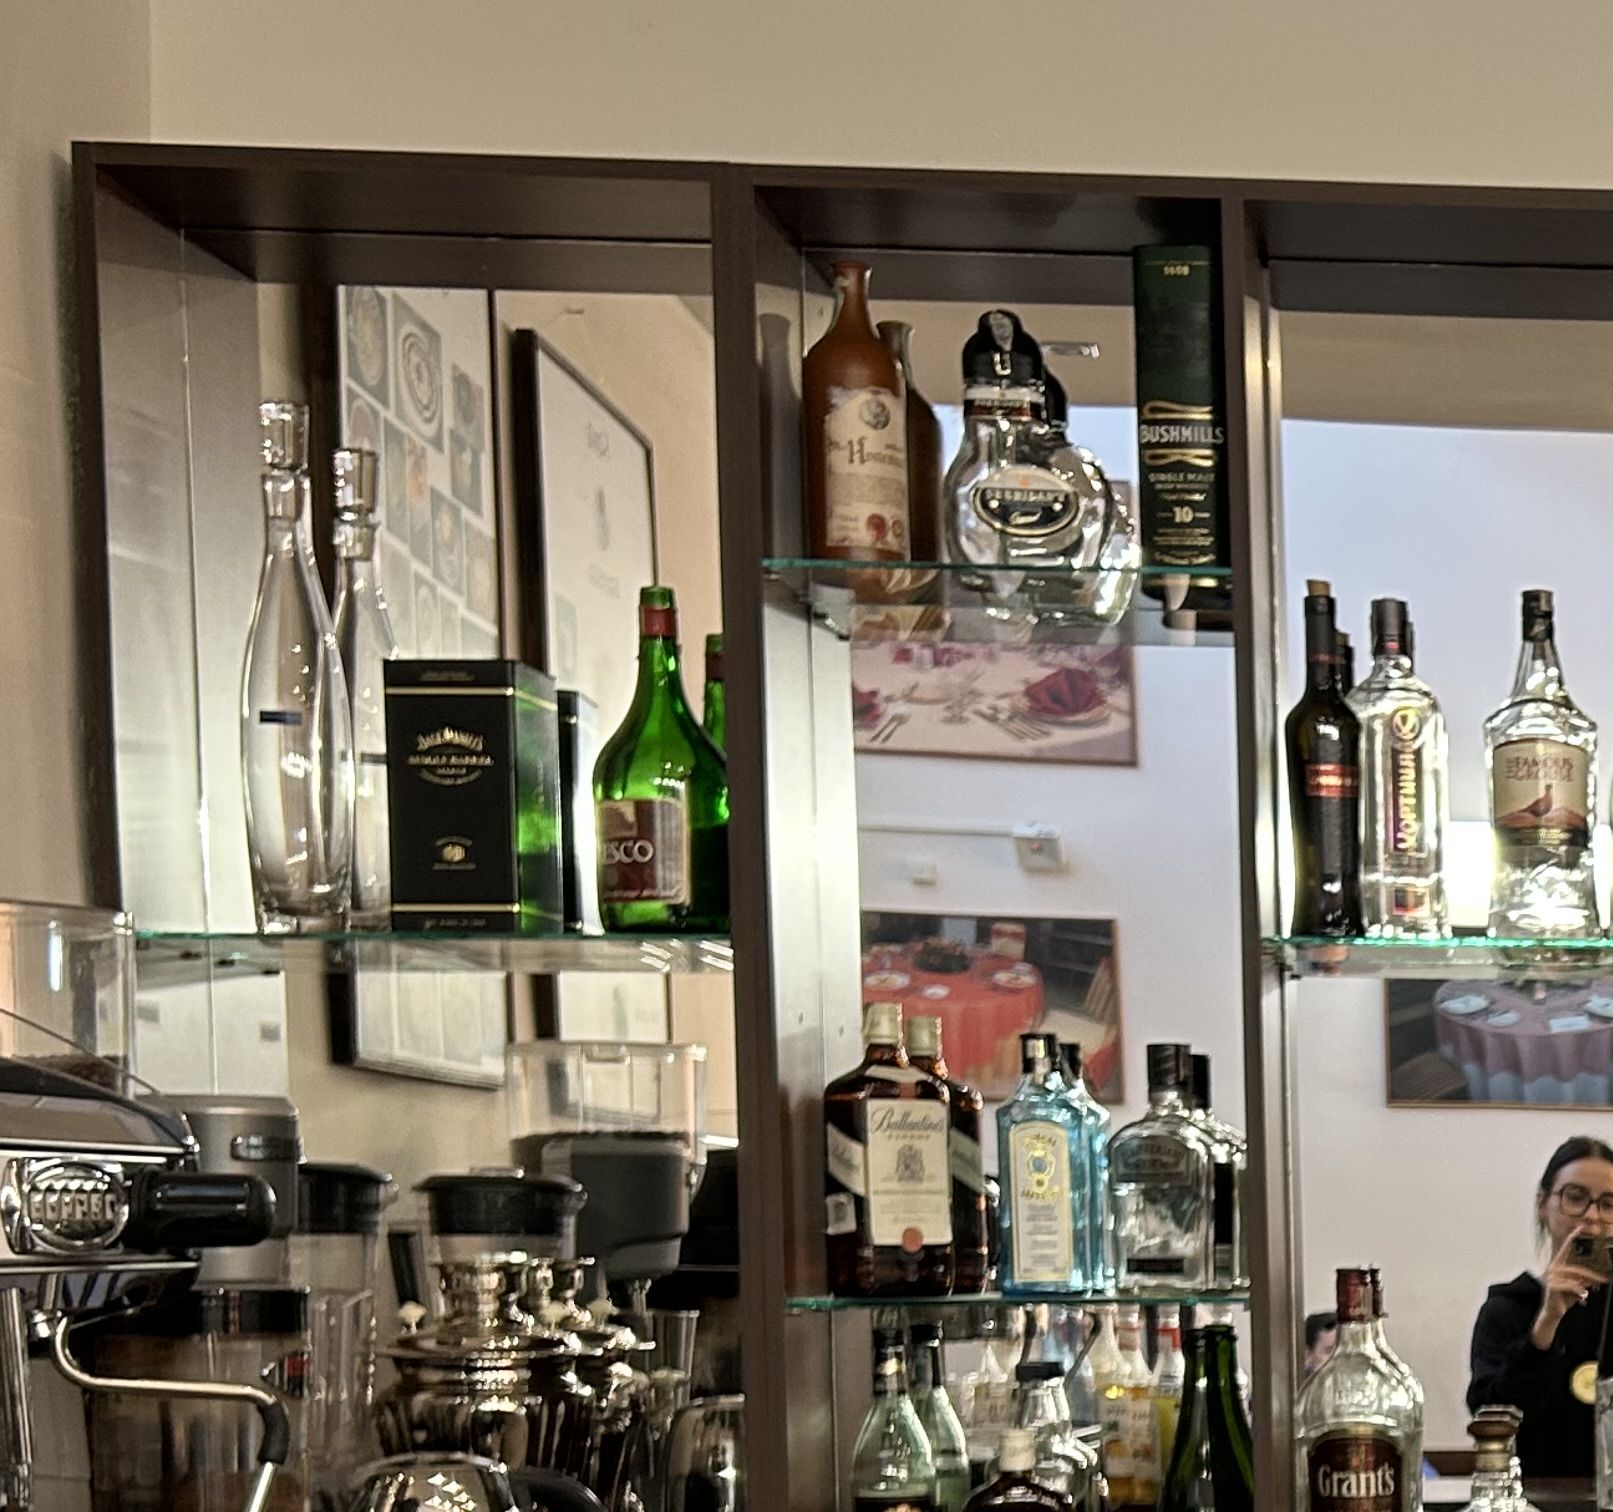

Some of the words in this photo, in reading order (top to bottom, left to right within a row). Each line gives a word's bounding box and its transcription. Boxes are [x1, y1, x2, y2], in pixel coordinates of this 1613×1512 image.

[1141, 424, 1224, 444] BUSHMILLS
[1174, 509, 1193, 522] 10
[1318, 1464, 1395, 1498] Grant's
